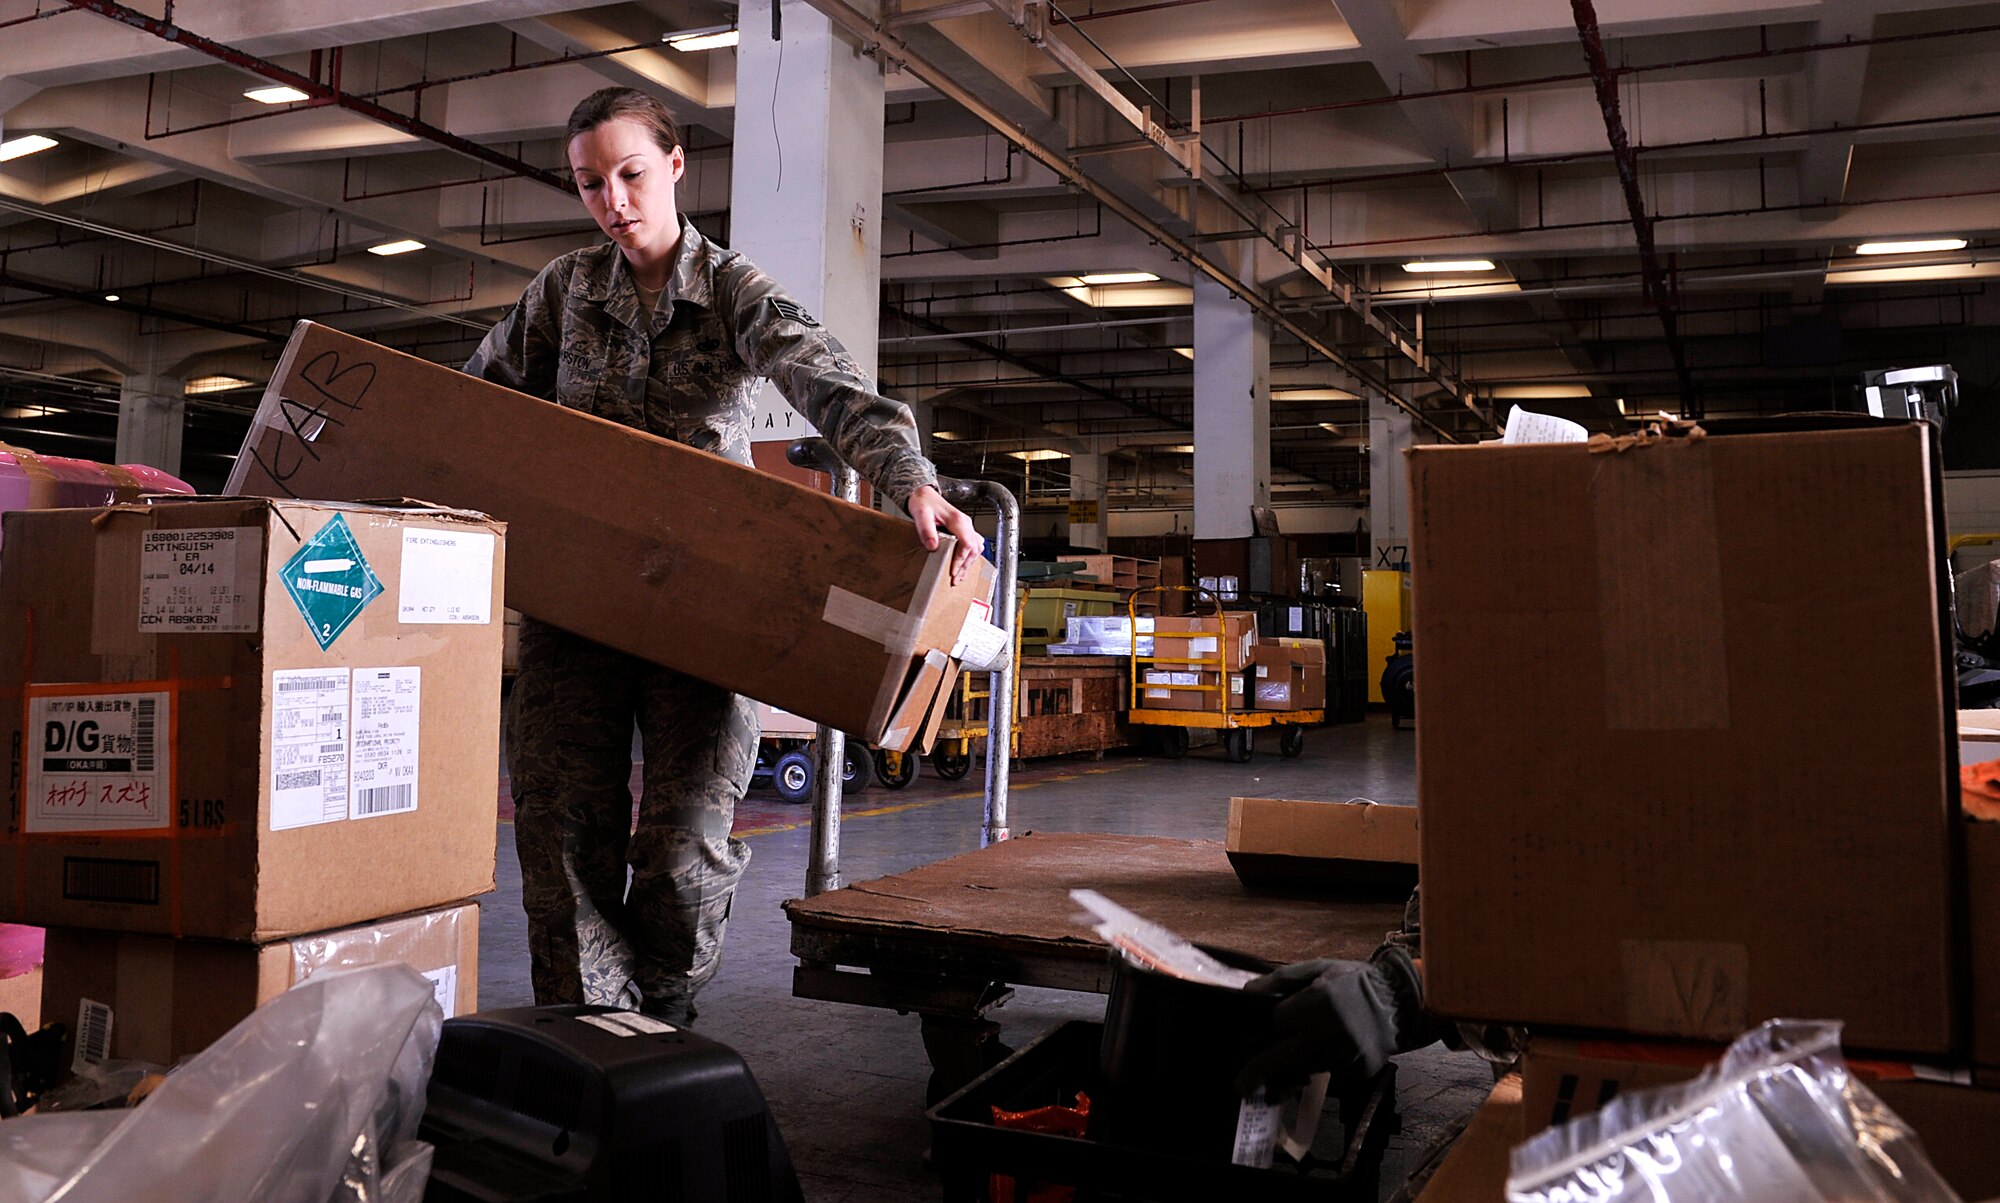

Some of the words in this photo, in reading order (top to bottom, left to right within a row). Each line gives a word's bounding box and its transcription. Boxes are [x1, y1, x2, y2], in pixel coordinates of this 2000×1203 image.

[561, 351, 592, 370] RSTON
[673, 361, 691, 376] U.S.
[144, 542, 214, 552] EXTINGUISH
[172, 553, 177, 562] 1
[185, 553, 200, 561] EA
[1377, 546, 1408, 567] X7
[180, 563, 214, 575] 04/14
[297, 577, 349, 597] NON-FLAMMABLE
[350, 586, 363, 599] GAS
[141, 615, 162, 624] CCN
[322, 623, 331, 637] 2
[45, 719, 100, 753] D/G
[336, 728, 342, 740] 1
[99, 781, 151, 809] スズキ
